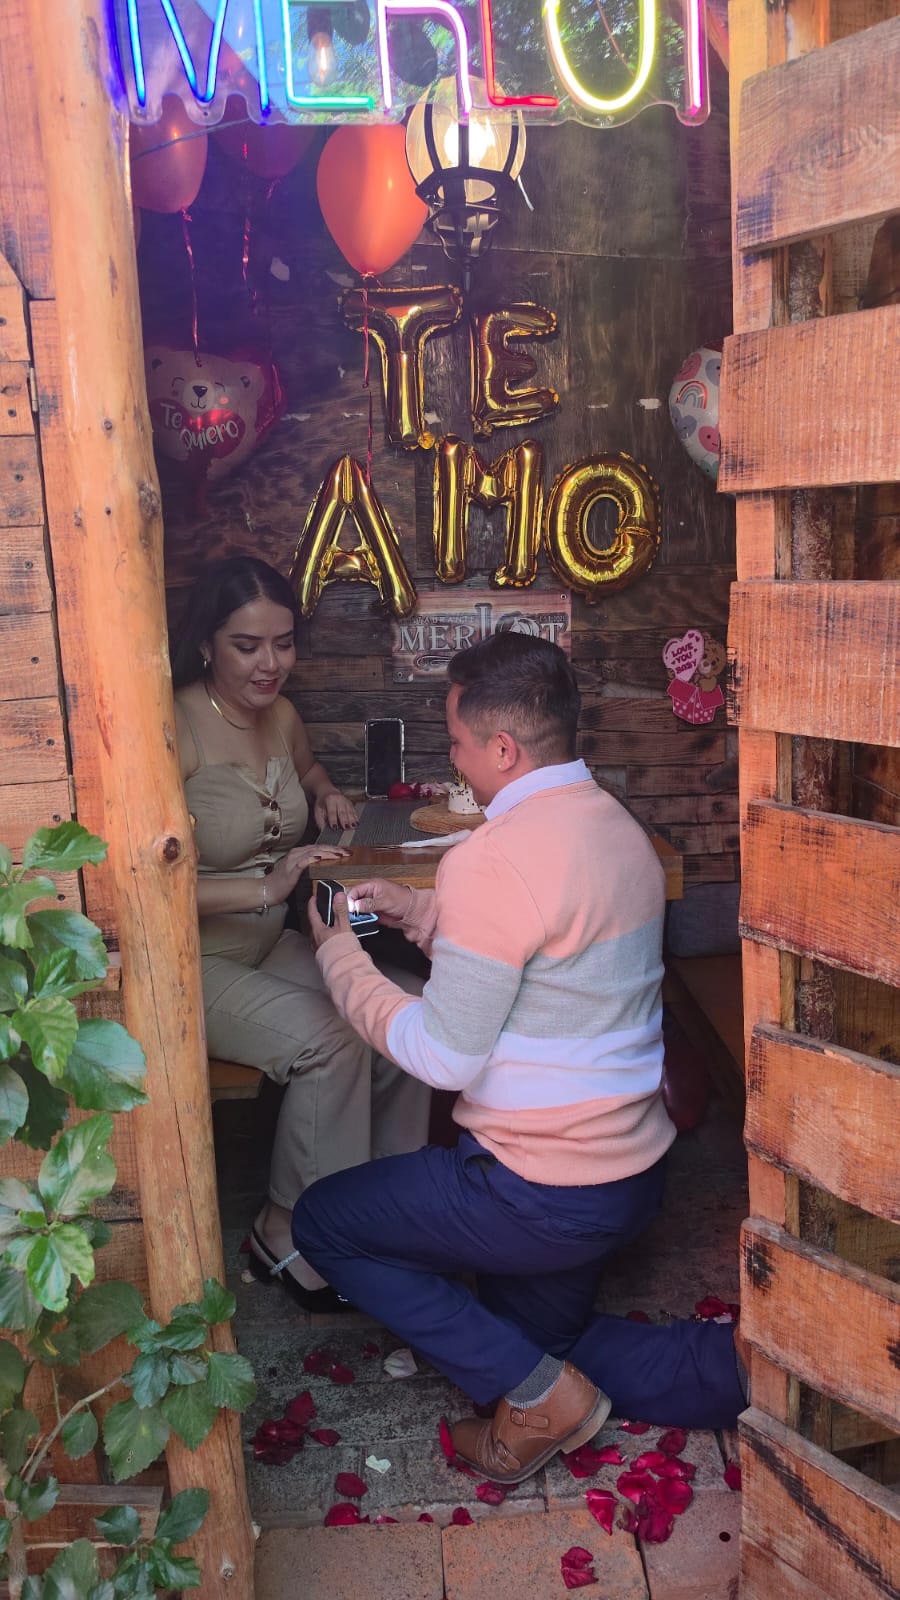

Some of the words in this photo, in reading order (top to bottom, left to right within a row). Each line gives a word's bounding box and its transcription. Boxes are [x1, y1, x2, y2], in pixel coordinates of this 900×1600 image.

[338, 284, 560, 450] TE
[160, 402, 183, 429] Te
[181, 419, 239, 451] Quiero
[291, 432, 663, 622] AMO
[671, 642, 693, 658] LOVE
[675, 651, 692, 663] YOU
